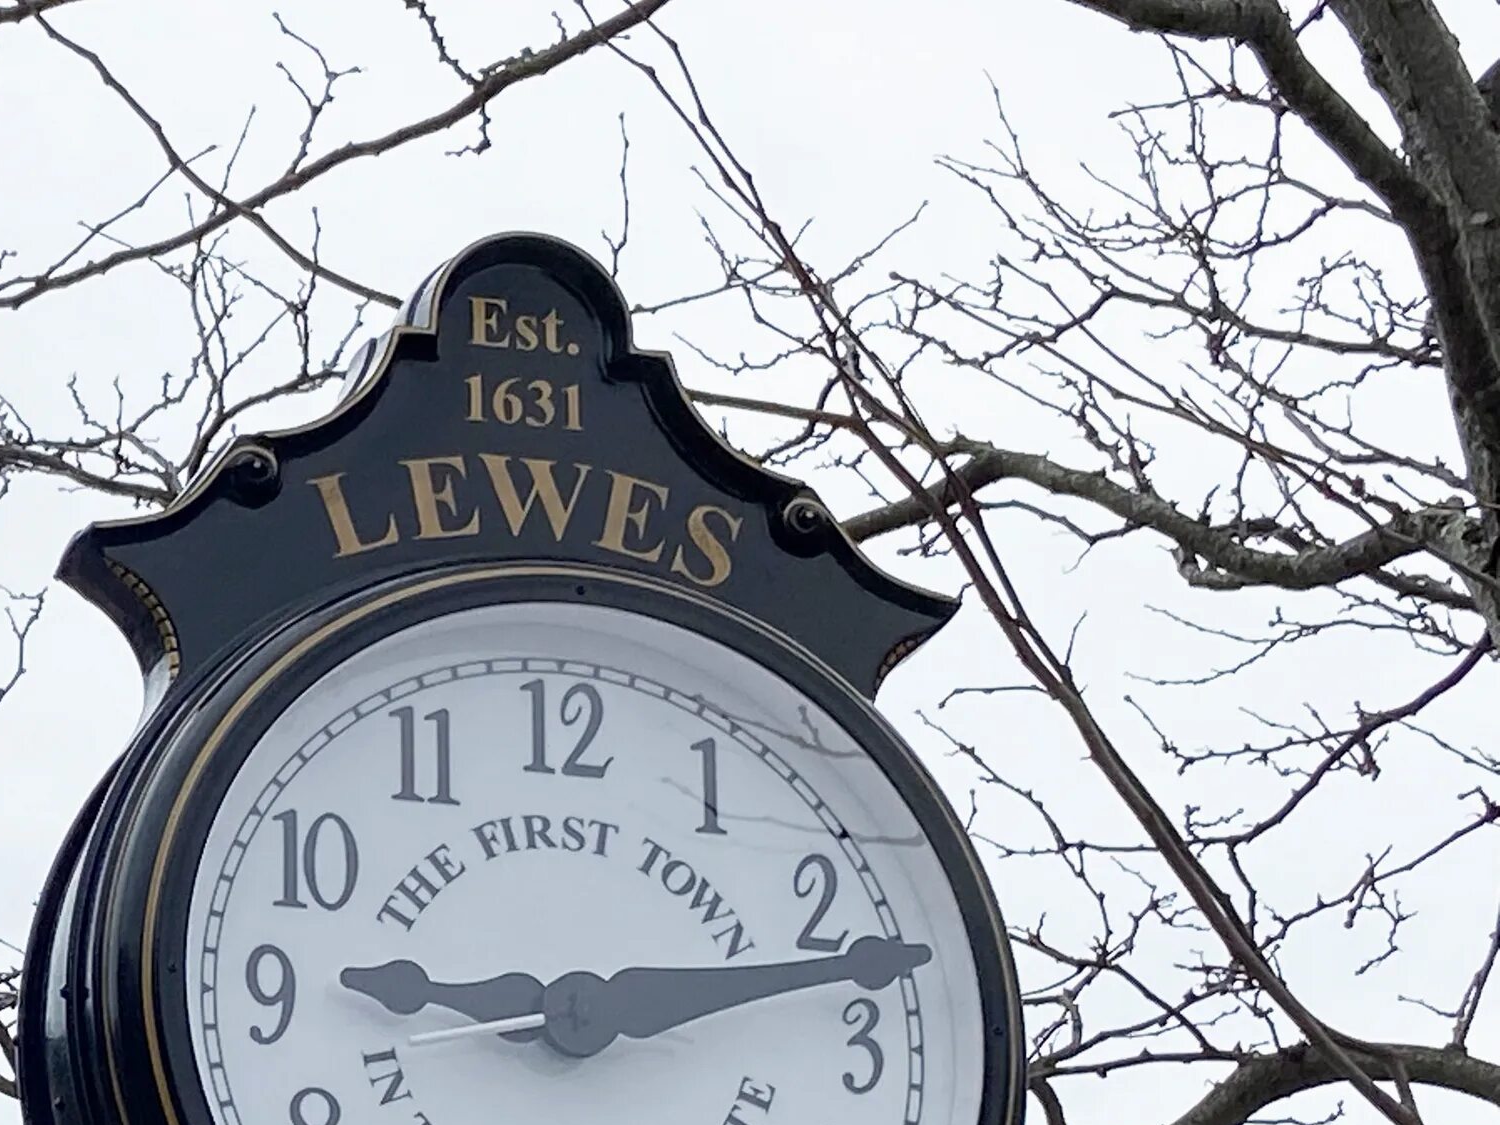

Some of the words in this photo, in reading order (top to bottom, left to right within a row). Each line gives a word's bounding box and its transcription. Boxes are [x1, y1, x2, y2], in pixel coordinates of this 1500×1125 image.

[468, 296, 581, 356] Est.
[464, 372, 584, 431] 1631
[306, 453, 745, 587] LEWES
[389, 705, 461, 806] 11
[519, 679, 614, 778] 12
[690, 737, 728, 835] 1
[272, 809, 359, 911] 10
[376, 843, 466, 932] THE
[470, 814, 619, 861] FIRST
[636, 837, 756, 960] TOWN
[793, 853, 850, 953] 2
[245, 944, 296, 1045] 9
[361, 1047, 413, 1106] IN
[842, 998, 884, 1094] 3
